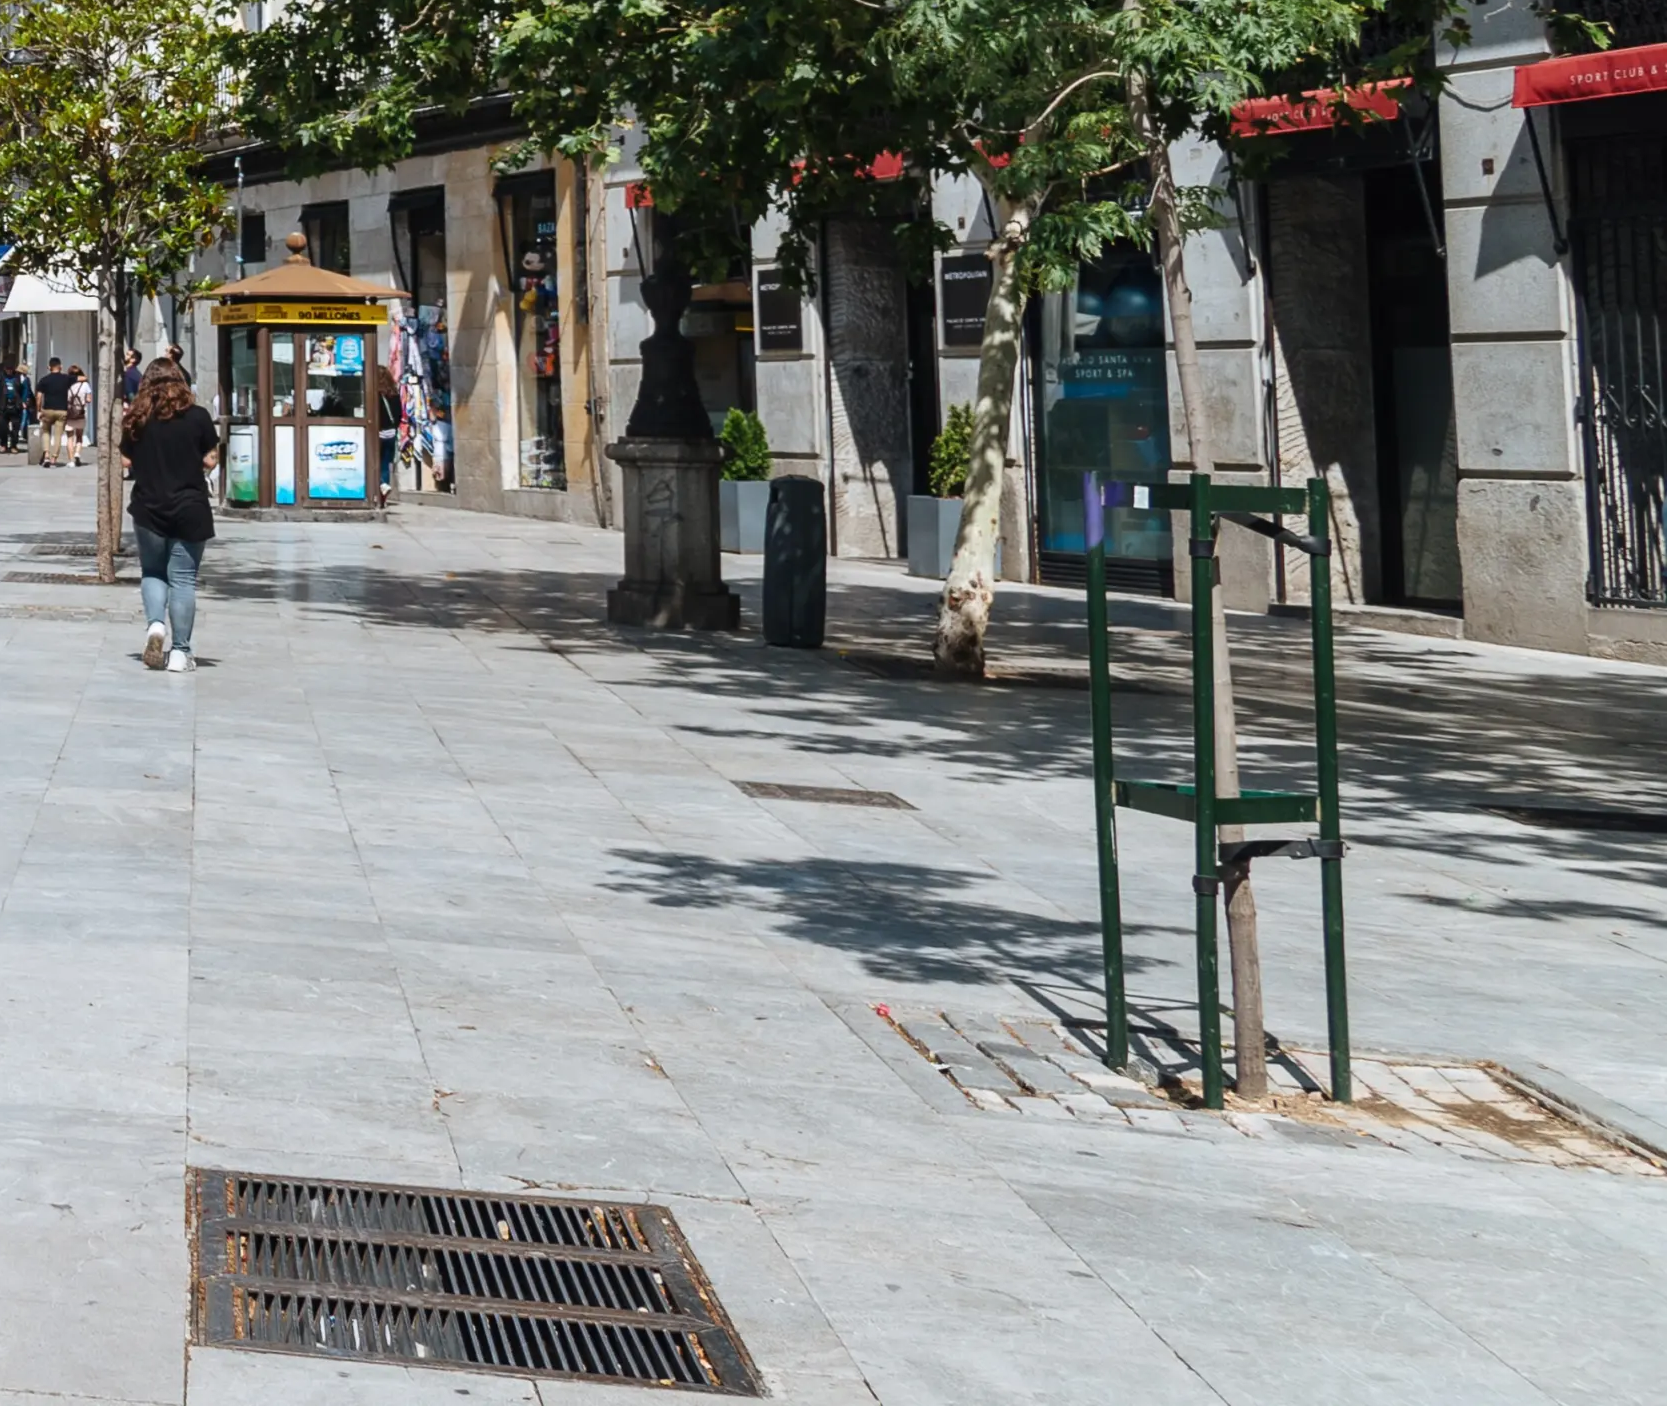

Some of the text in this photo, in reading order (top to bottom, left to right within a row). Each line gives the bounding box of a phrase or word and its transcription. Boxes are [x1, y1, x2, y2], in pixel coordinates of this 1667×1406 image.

[1569, 65, 1658, 86] SPORT CLUB &
[298, 311, 361, 321] 90 MILLONES
[1075, 368, 1102, 378] SPORT
[1117, 368, 1134, 378] SPA
